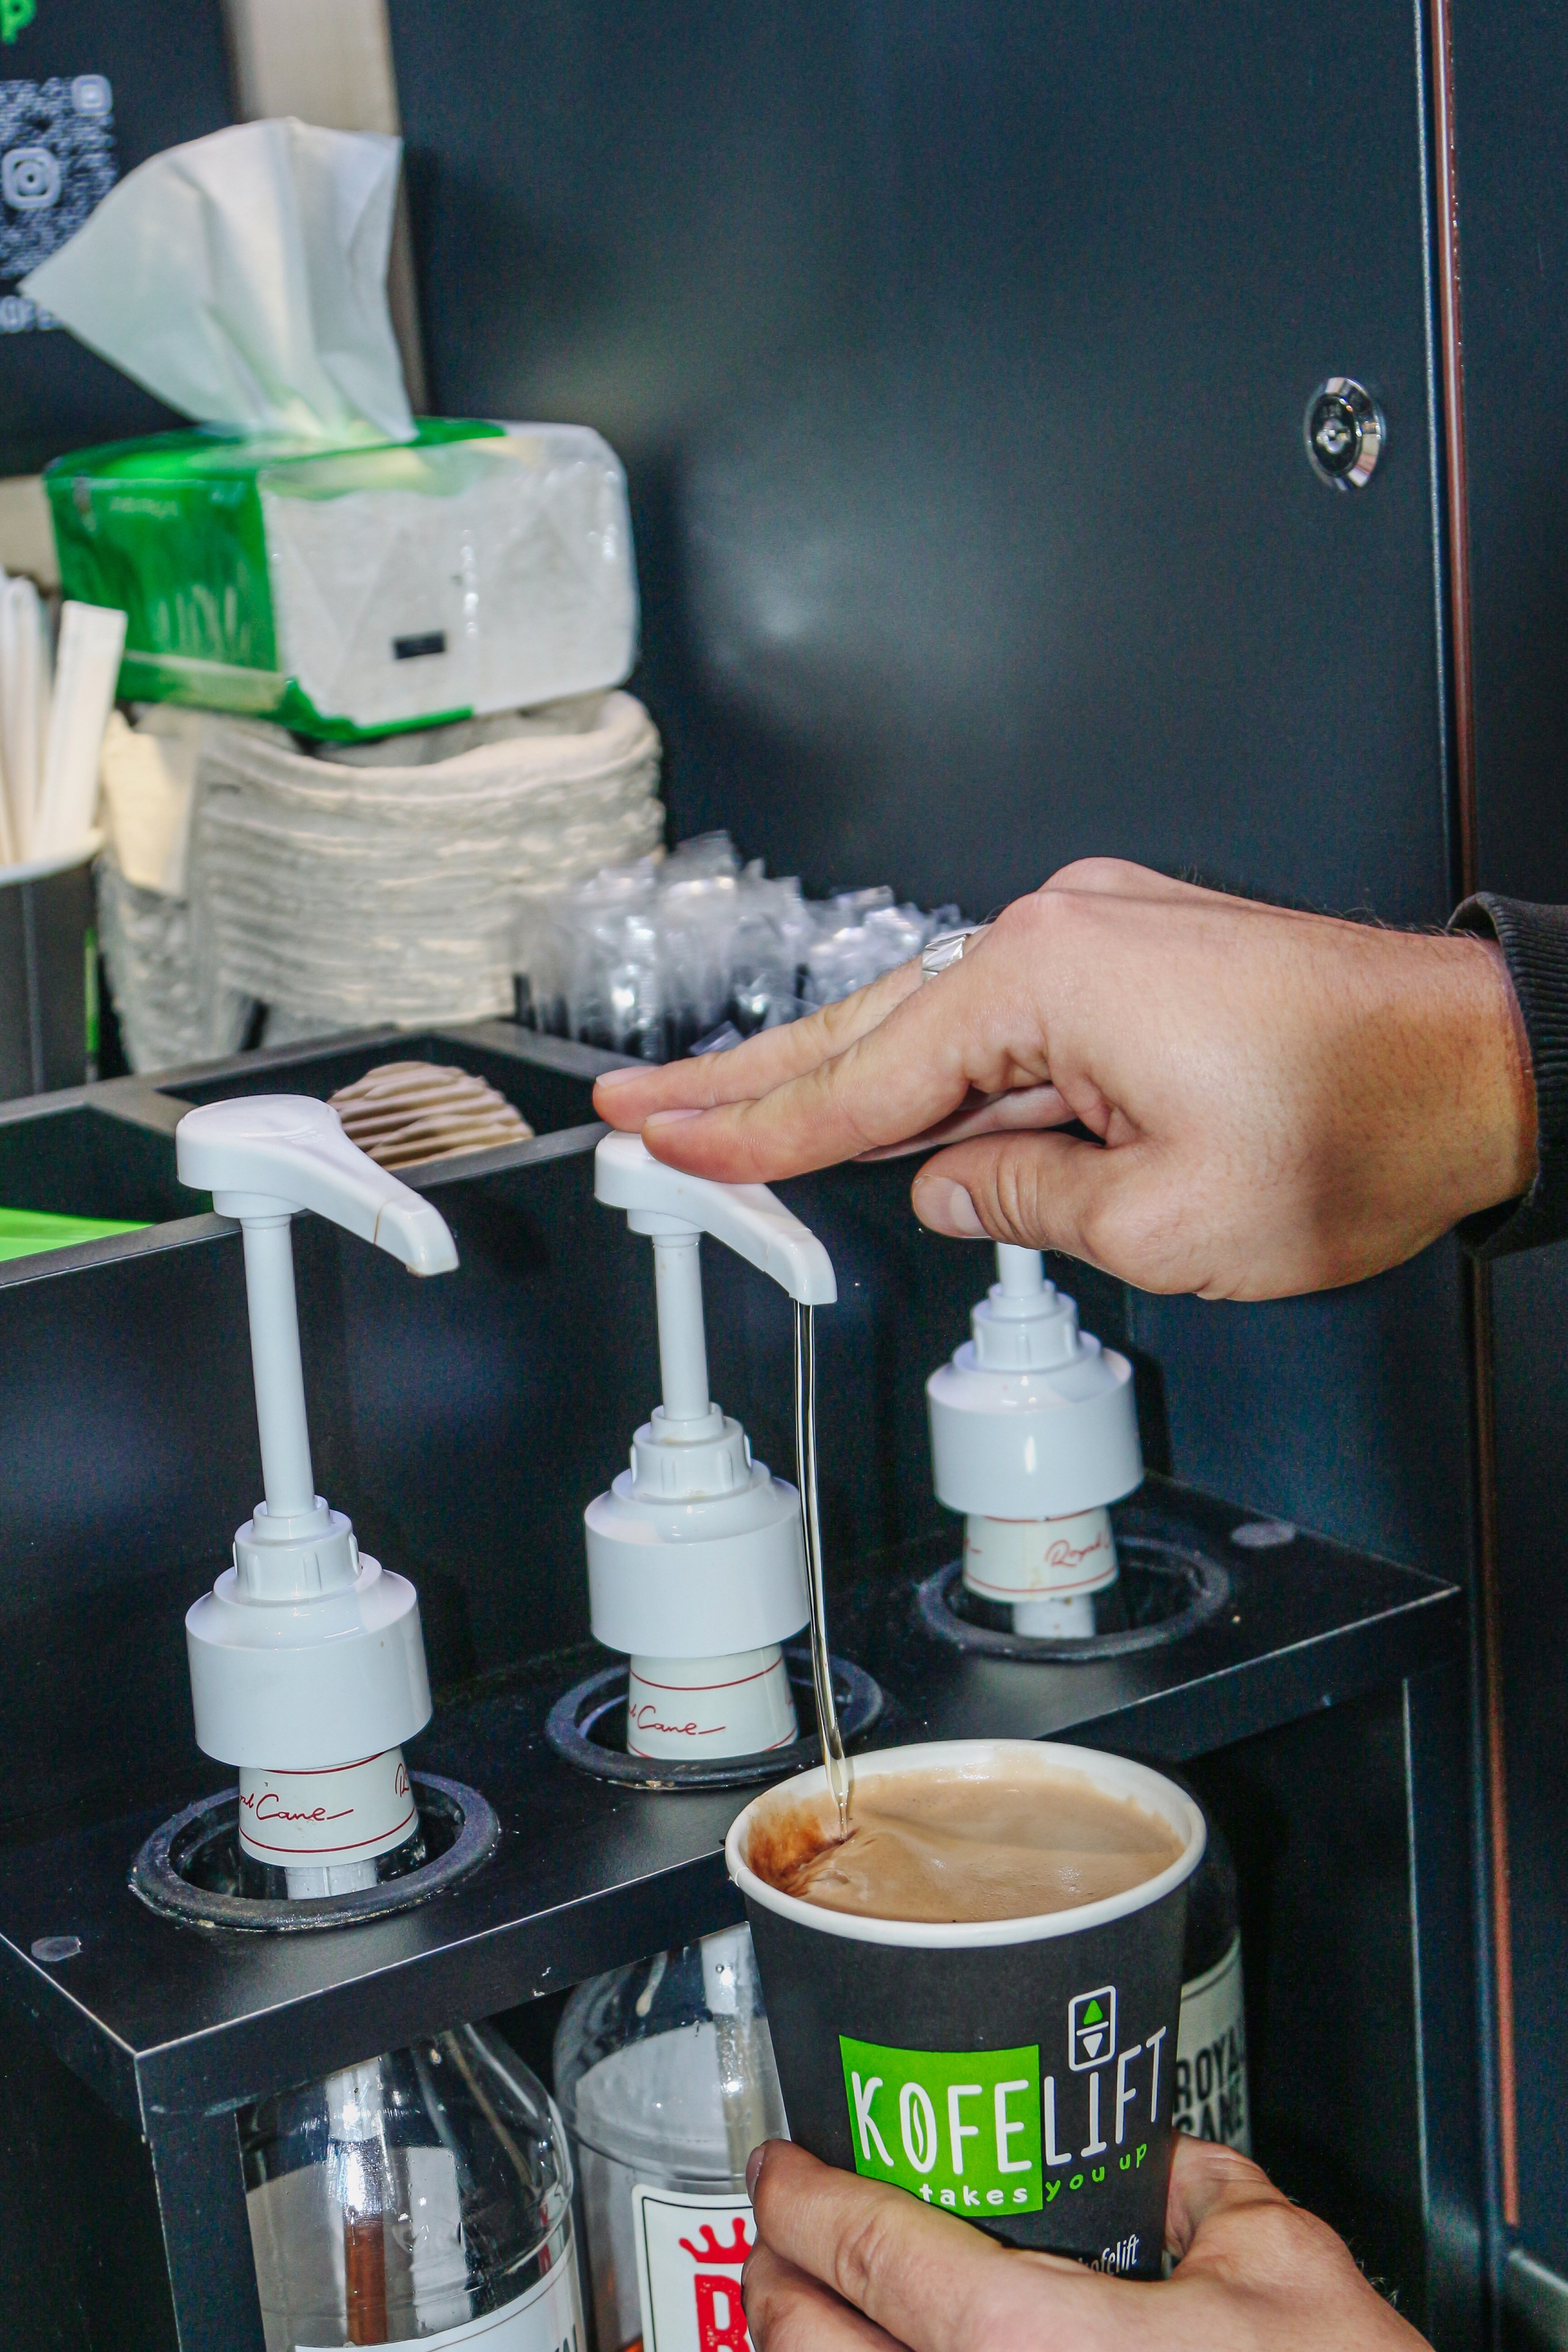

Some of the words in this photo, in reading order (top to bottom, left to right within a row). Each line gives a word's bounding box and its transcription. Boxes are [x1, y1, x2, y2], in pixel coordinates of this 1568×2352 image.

[637, 1705, 726, 1735] Cane
[256, 1793, 354, 1821] Cane
[919, 2183, 1028, 2206] takes
[1045, 2165, 1105, 2203] you
[1119, 2143, 1147, 2169] up
[1077, 2234, 1139, 2275] ofelift
